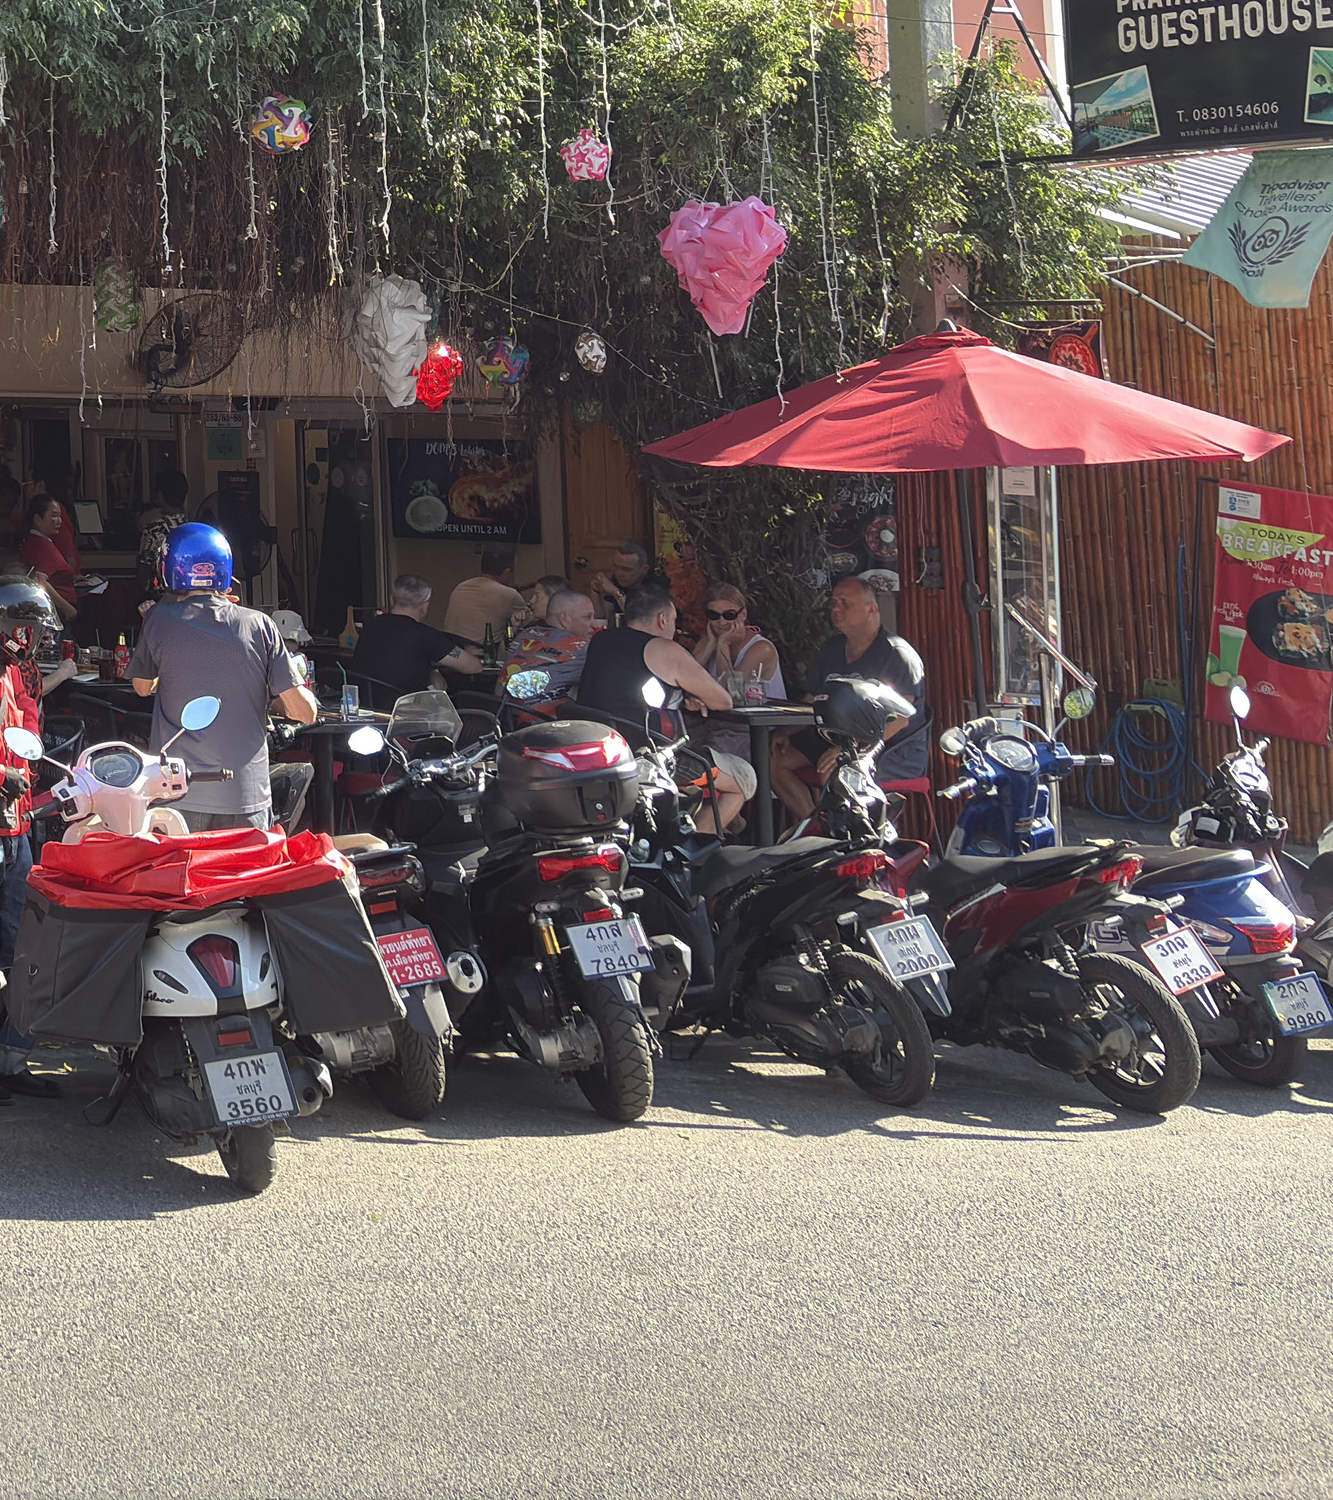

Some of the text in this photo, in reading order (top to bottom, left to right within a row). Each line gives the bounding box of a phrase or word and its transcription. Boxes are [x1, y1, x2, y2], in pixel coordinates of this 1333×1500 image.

[1192, 102, 1279, 121] 0830154606
[461, 524, 485, 534] UNTIL
[487, 526, 492, 534] 2
[1250, 527, 1305, 544] TODAY'S
[1222, 533, 1333, 566] BREAKFAST
[591, 954, 639, 974] 7840
[897, 954, 939, 975] 2000
[1173, 964, 1211, 989] 8339
[1287, 1010, 1326, 1029] 9980
[236, 1080, 262, 1095] ชลบุรี
[227, 1095, 282, 1118] 3560
